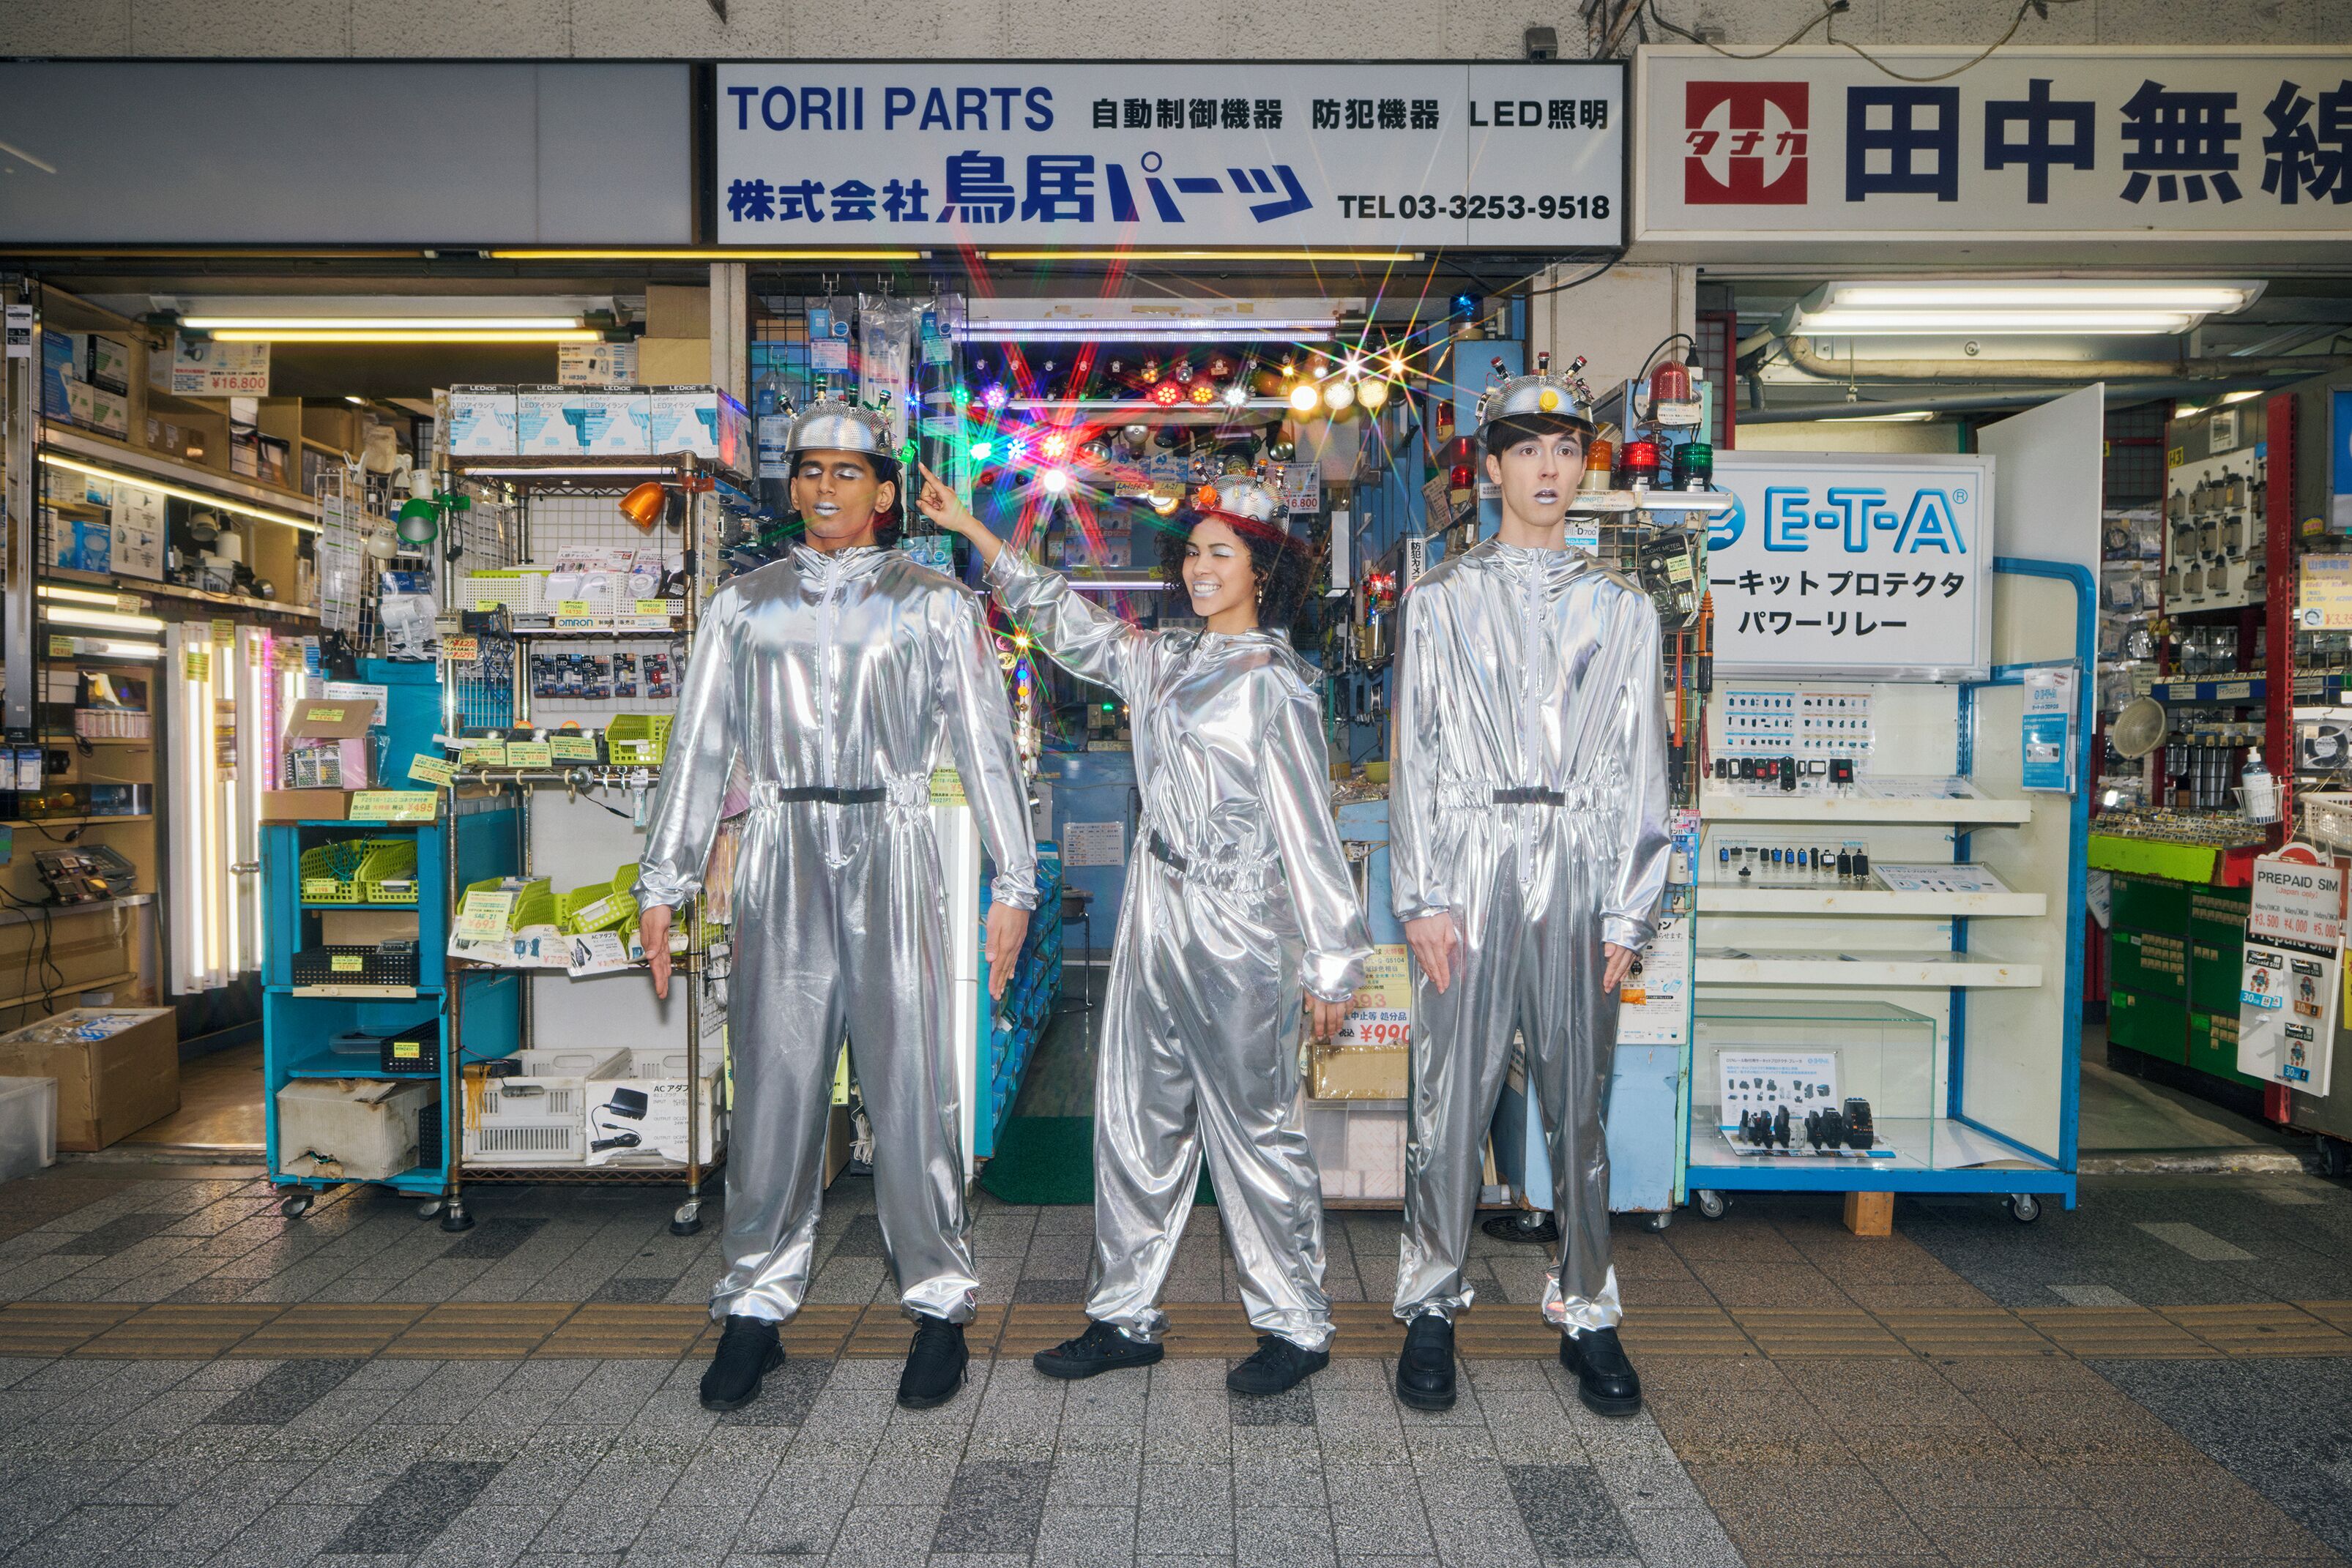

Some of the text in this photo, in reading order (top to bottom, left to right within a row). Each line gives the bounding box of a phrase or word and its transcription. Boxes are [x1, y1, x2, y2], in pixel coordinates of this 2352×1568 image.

[727, 86, 1054, 131] TORII PARTS
[1093, 98, 1283, 129] 自動制御機器
[1312, 98, 1440, 129] 防犯機器
[1470, 99, 1608, 129] LED照明
[1685, 130, 1809, 156] タナカ
[2169, 450, 2182, 466] H3
[1661, 542, 1681, 552] METER
[1831, 571, 1965, 597] プロテクタ
[1738, 611, 1907, 636] パワーリレー
[407, 803, 433, 812] ¥495
[2258, 871, 2338, 892] PREPAID SIM
[2248, 957, 2280, 969] Prepaid SIM
[2293, 965, 2309, 973] Prepaid
[1380, 1012, 1407, 1021] 処分品
[2286, 1030, 2303, 1039] Prepaid
